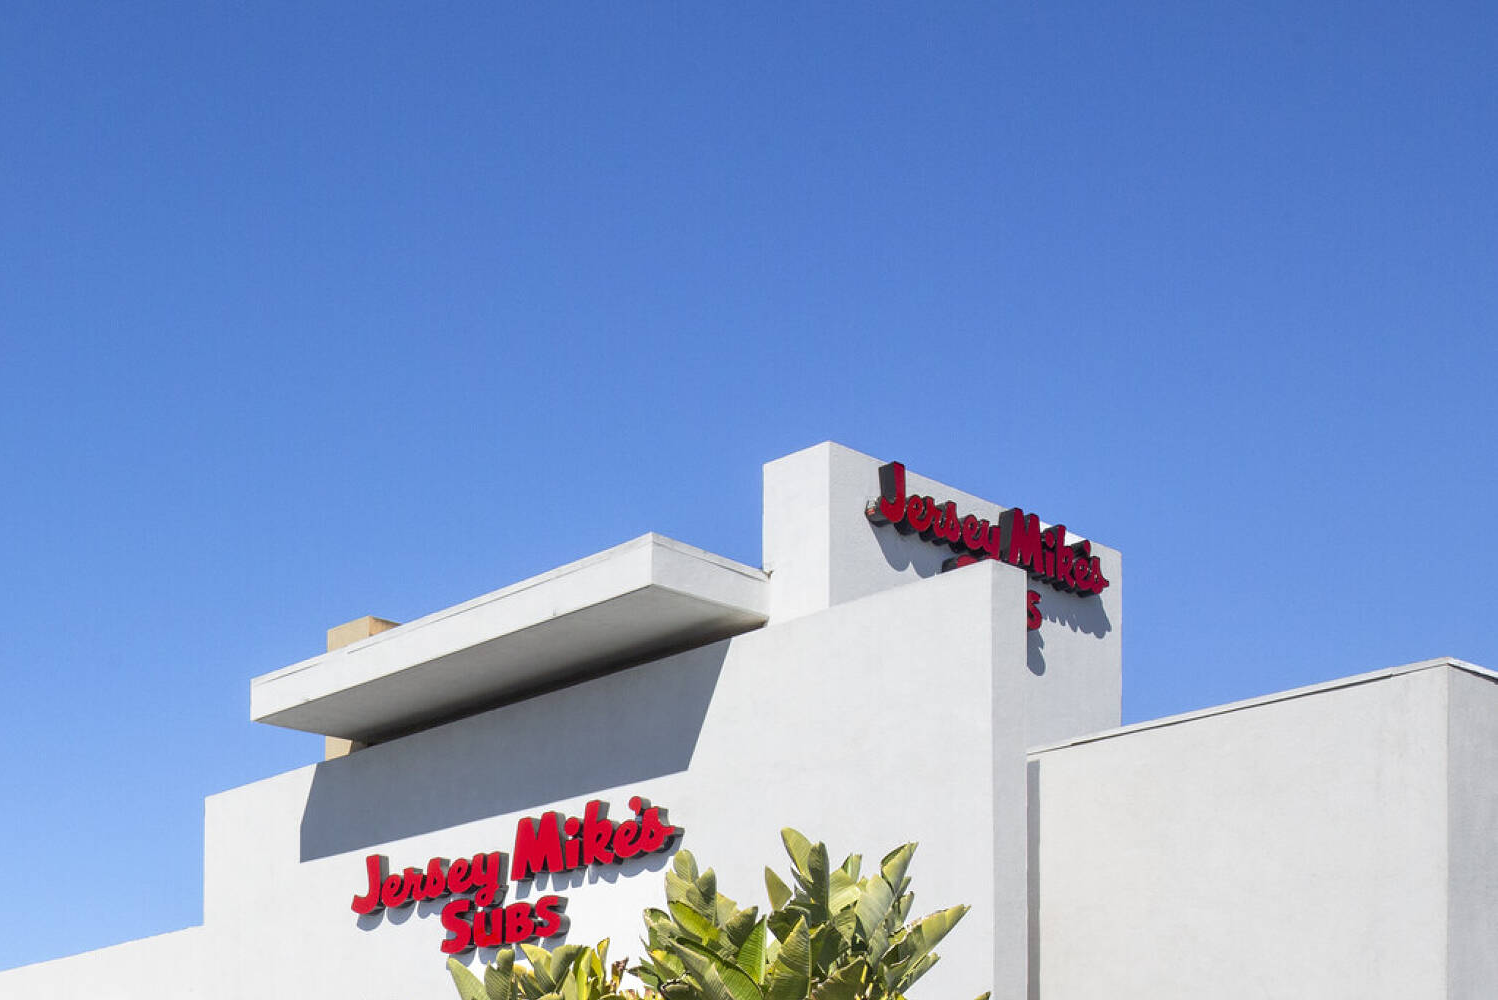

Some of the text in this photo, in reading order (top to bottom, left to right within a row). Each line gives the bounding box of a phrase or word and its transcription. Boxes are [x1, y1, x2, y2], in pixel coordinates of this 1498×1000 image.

[1008, 508, 1110, 595] Mike's
[351, 796, 675, 914] Jersey Mike's
[440, 895, 561, 954] SUBS
